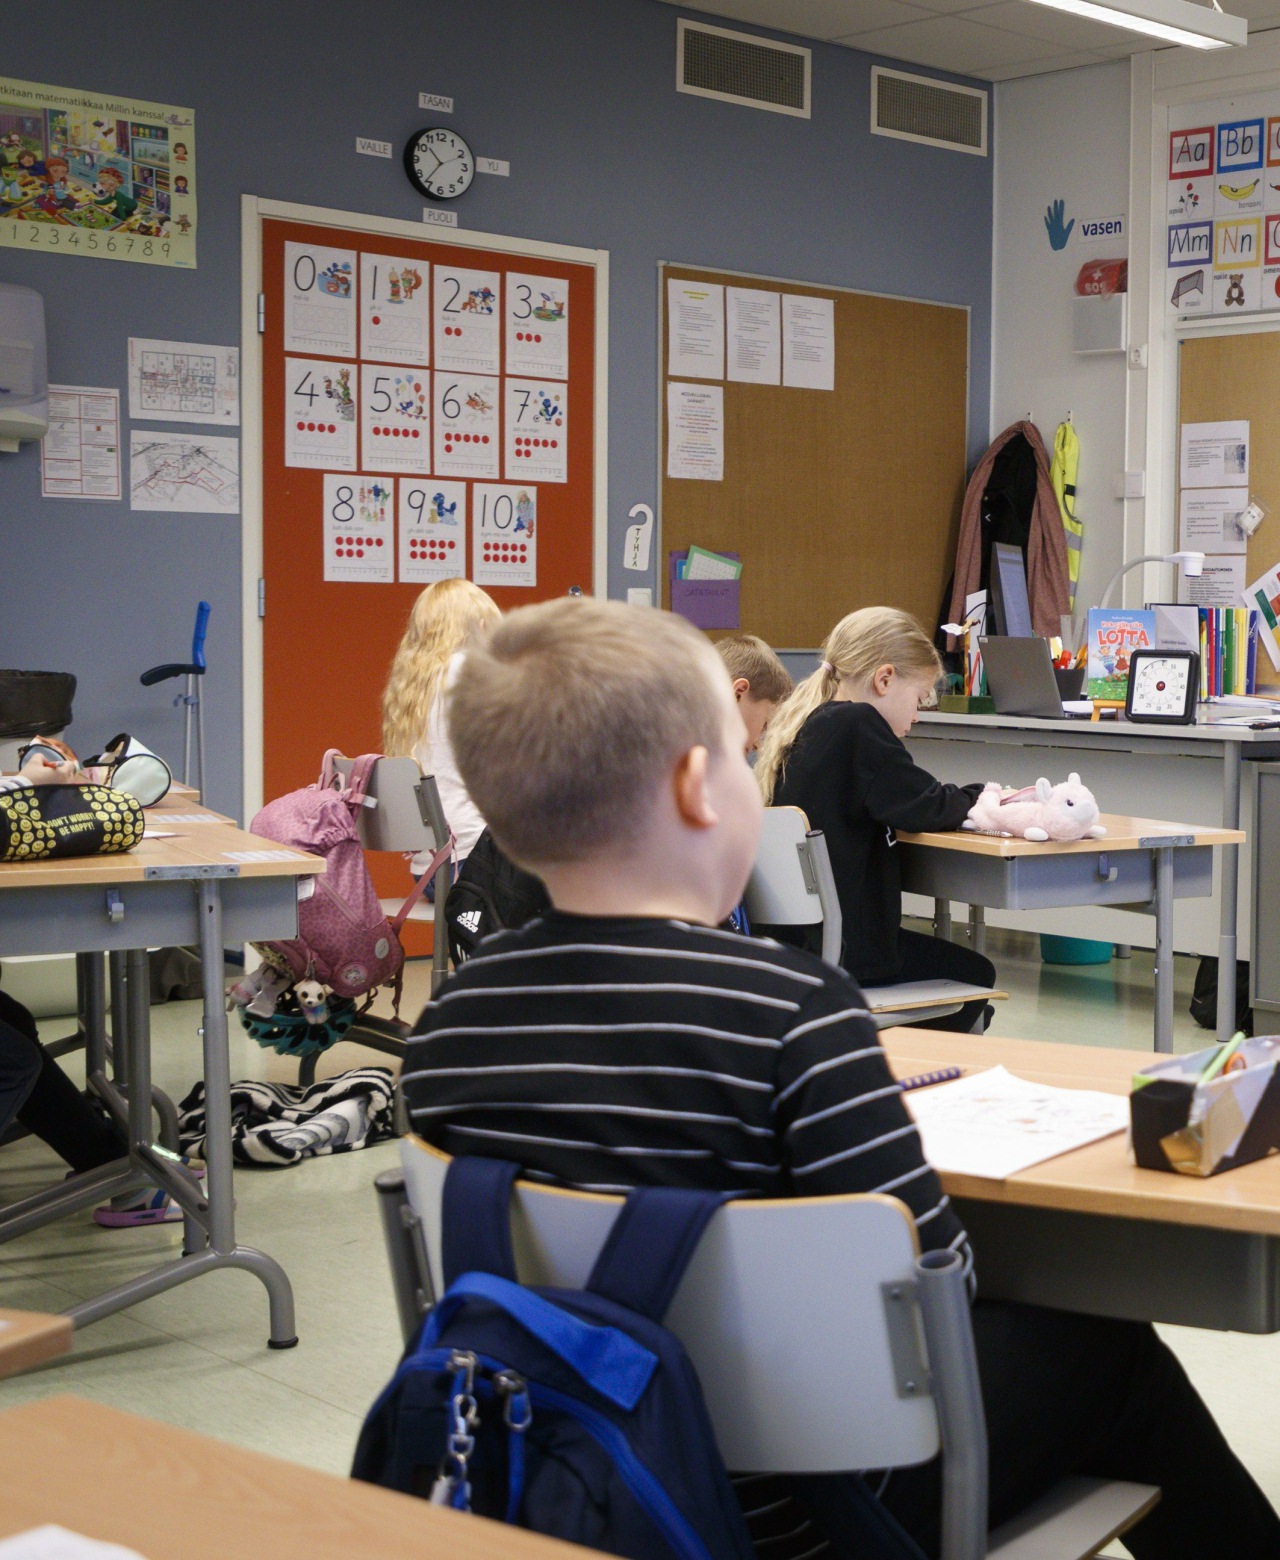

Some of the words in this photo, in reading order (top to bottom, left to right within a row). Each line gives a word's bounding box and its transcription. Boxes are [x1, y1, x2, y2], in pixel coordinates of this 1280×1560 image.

[35, 92, 104, 111] matematiikkaa
[105, 104, 131, 115] Millin
[132, 109, 165, 120] kanssa!
[421, 94, 451, 109] TASAN
[417, 142, 428, 153] 10
[425, 134, 434, 144] 11
[436, 132, 447, 143] 12
[450, 139, 455, 148] 1
[1225, 126, 1254, 158] Bb
[457, 149, 465, 159] 2
[1176, 135, 1206, 164] Aa
[460, 162, 468, 173] 3
[436, 185, 444, 195] 6
[448, 184, 456, 194] 5
[456, 175, 464, 185] 4
[427, 210, 453, 224] PUOLI
[1082, 220, 1123, 237] vasen
[12, 225, 17, 240] 1
[30, 226, 40, 243] 2
[49, 228, 60, 245] 3
[68, 231, 80, 247] 4
[88, 234, 99, 250] 5
[107, 236, 117, 252] 6
[124, 238, 135, 254] 7
[142, 241, 154, 257] 8
[161, 243, 172, 258] 9
[1170, 228, 1209, 255] Mm
[1223, 226, 1252, 255] Nn
[294, 255, 316, 292] 0
[442, 277, 462, 314] 2
[512, 284, 532, 319] 3
[294, 370, 320, 407] 4
[370, 377, 392, 413] 5
[442, 384, 461, 419] 6
[512, 389, 532, 423] 7
[332, 485, 355, 522] 8
[407, 489, 426, 524] 9
[481, 493, 513, 529] 10
[1097, 628, 1150, 647] LOTTA
[58, 827, 70, 836] BE
[69, 821, 95, 833] HAPPY!
[68, 811, 96, 823] WORRY!
[456, 914, 479, 933] adidas
